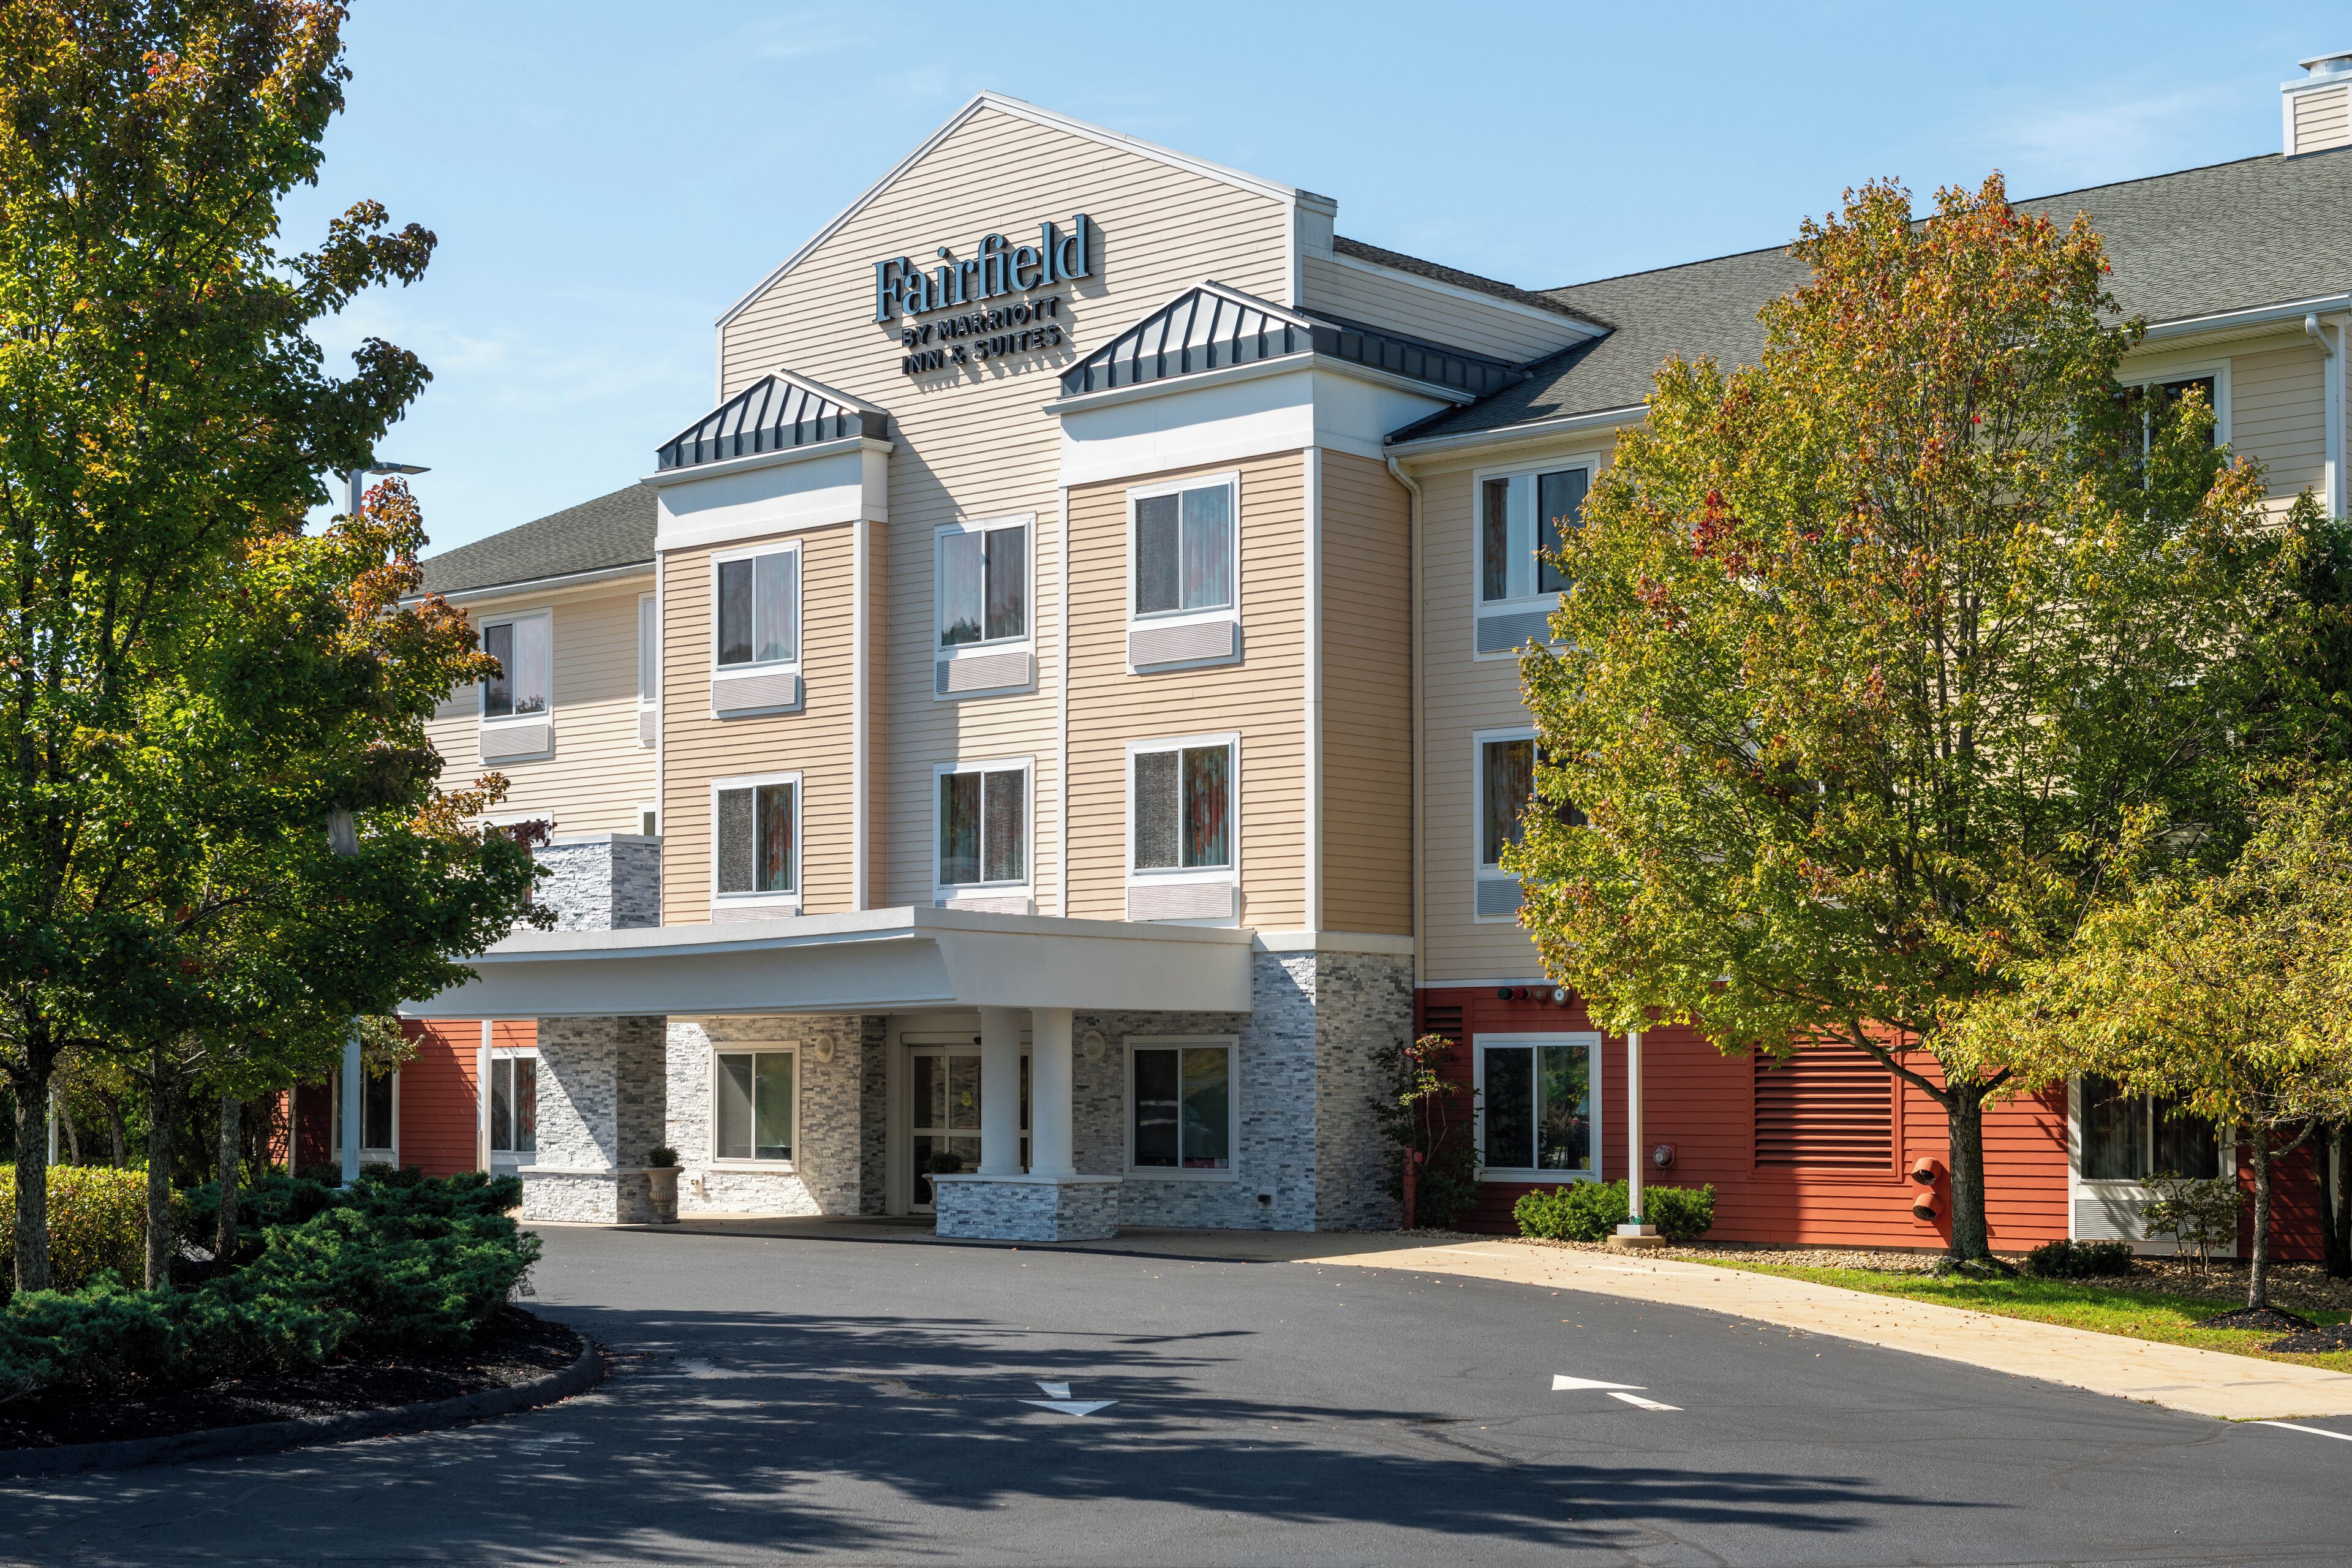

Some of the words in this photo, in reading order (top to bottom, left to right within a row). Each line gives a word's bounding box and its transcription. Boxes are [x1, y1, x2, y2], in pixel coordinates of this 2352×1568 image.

[872, 213, 1093, 323] Fairfield
[902, 323, 932, 348] BY
[938, 296, 1060, 341] MARRIOTT
[902, 349, 944, 375] INN
[951, 344, 967, 366] &
[974, 325, 1061, 361] SUITES
